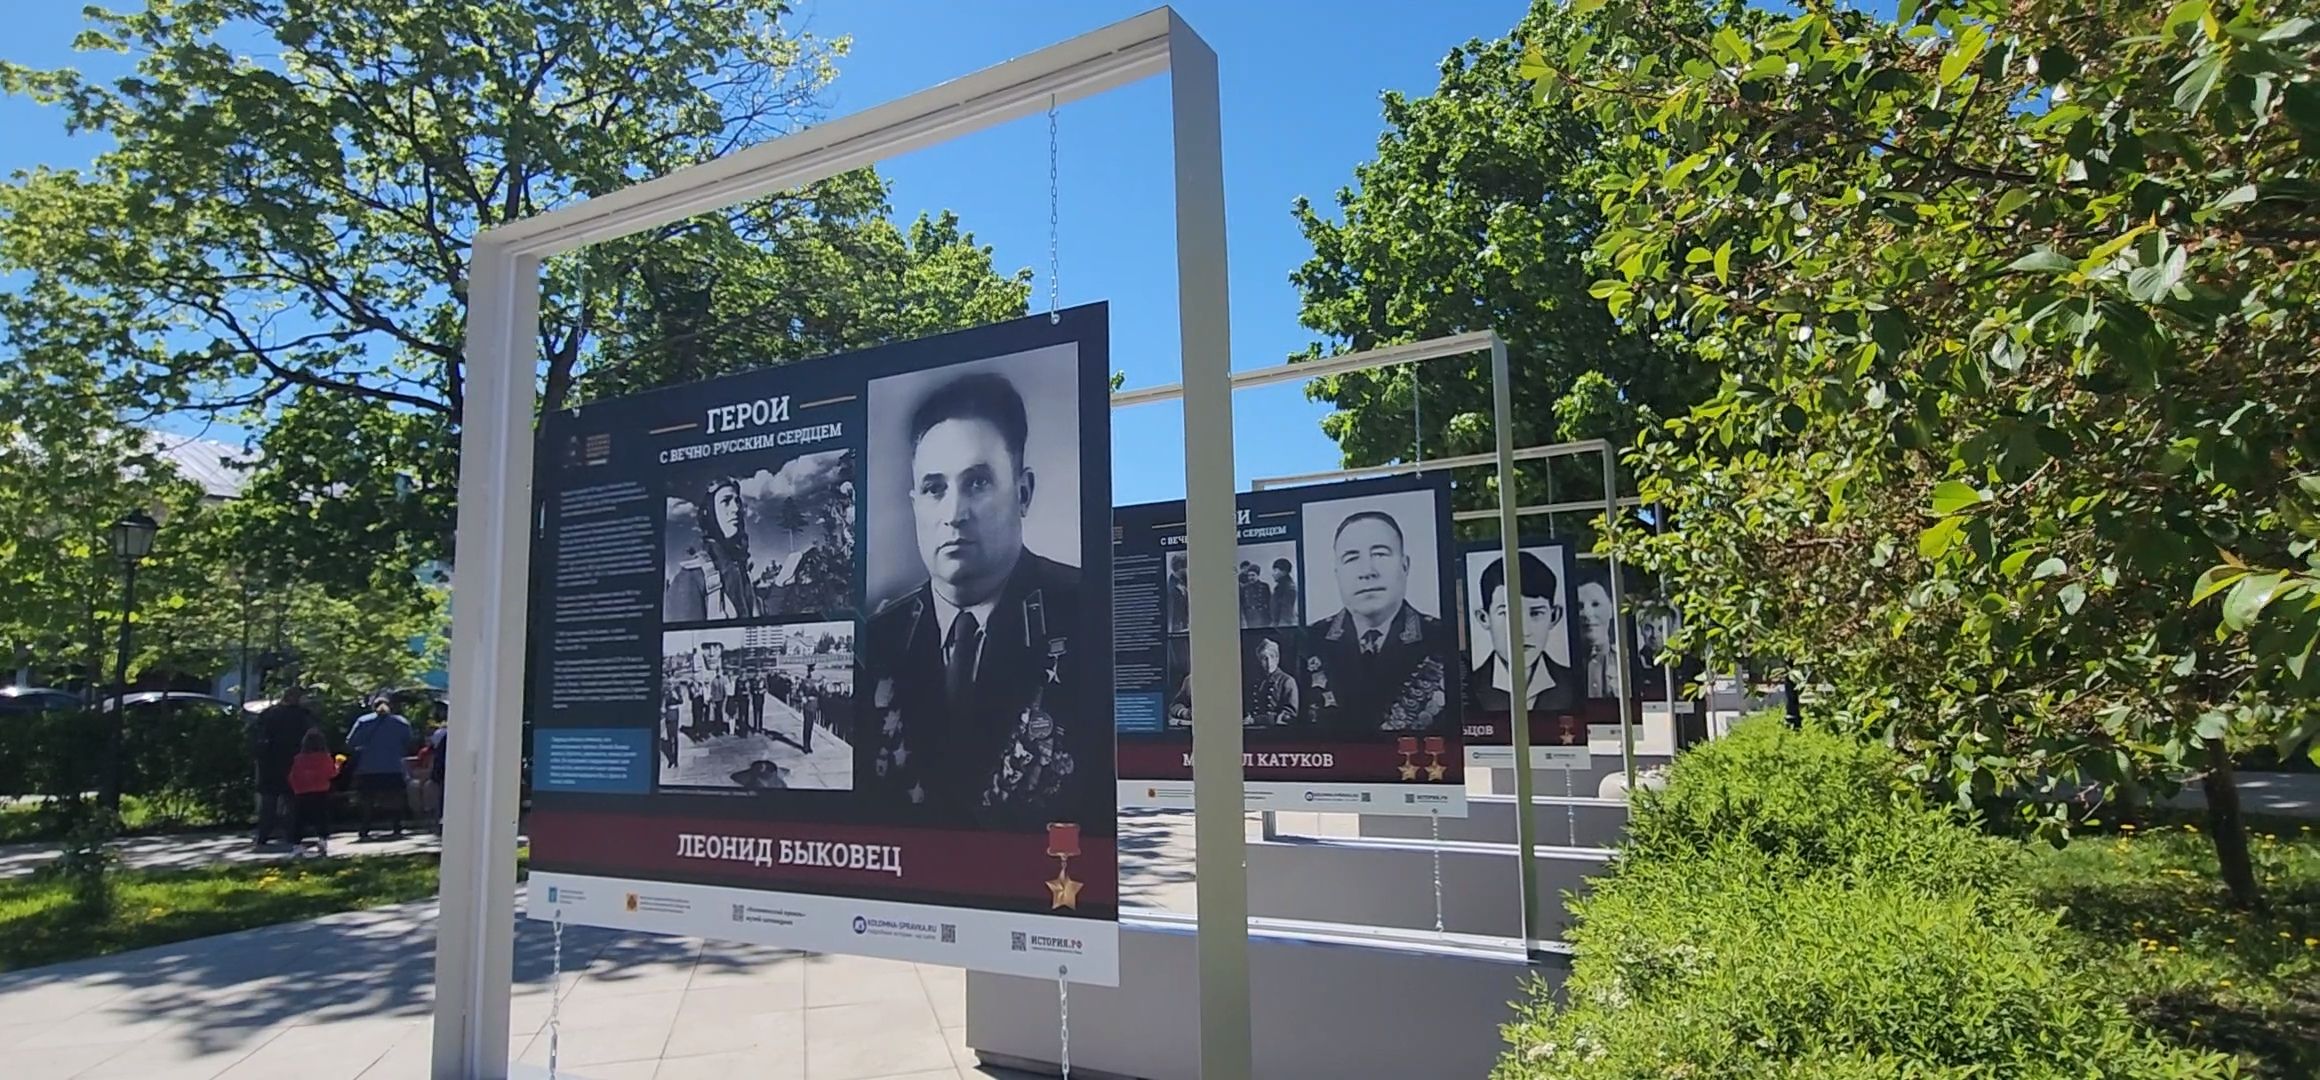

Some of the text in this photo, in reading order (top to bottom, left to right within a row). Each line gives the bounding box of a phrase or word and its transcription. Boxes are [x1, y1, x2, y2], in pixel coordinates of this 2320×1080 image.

[706, 395, 790, 434] ГЕРОИ
[659, 423, 843, 464] С ВЕЧНО РУССКИМ СЕРДЦЕМ
[1160, 537, 1167, 545] С
[1167, 535, 1188, 545] ВЕЧ
[1242, 525, 1287, 539] СЕРДЦЕМ
[1463, 725, 1494, 737] ЬЦОВ
[1257, 752, 1334, 767] КАТУКОВ
[676, 833, 902, 877] ЛЕОНИД БЫКОВЕЦ
[1031, 935, 1083, 949] ИСТОРИЯ.РФ
